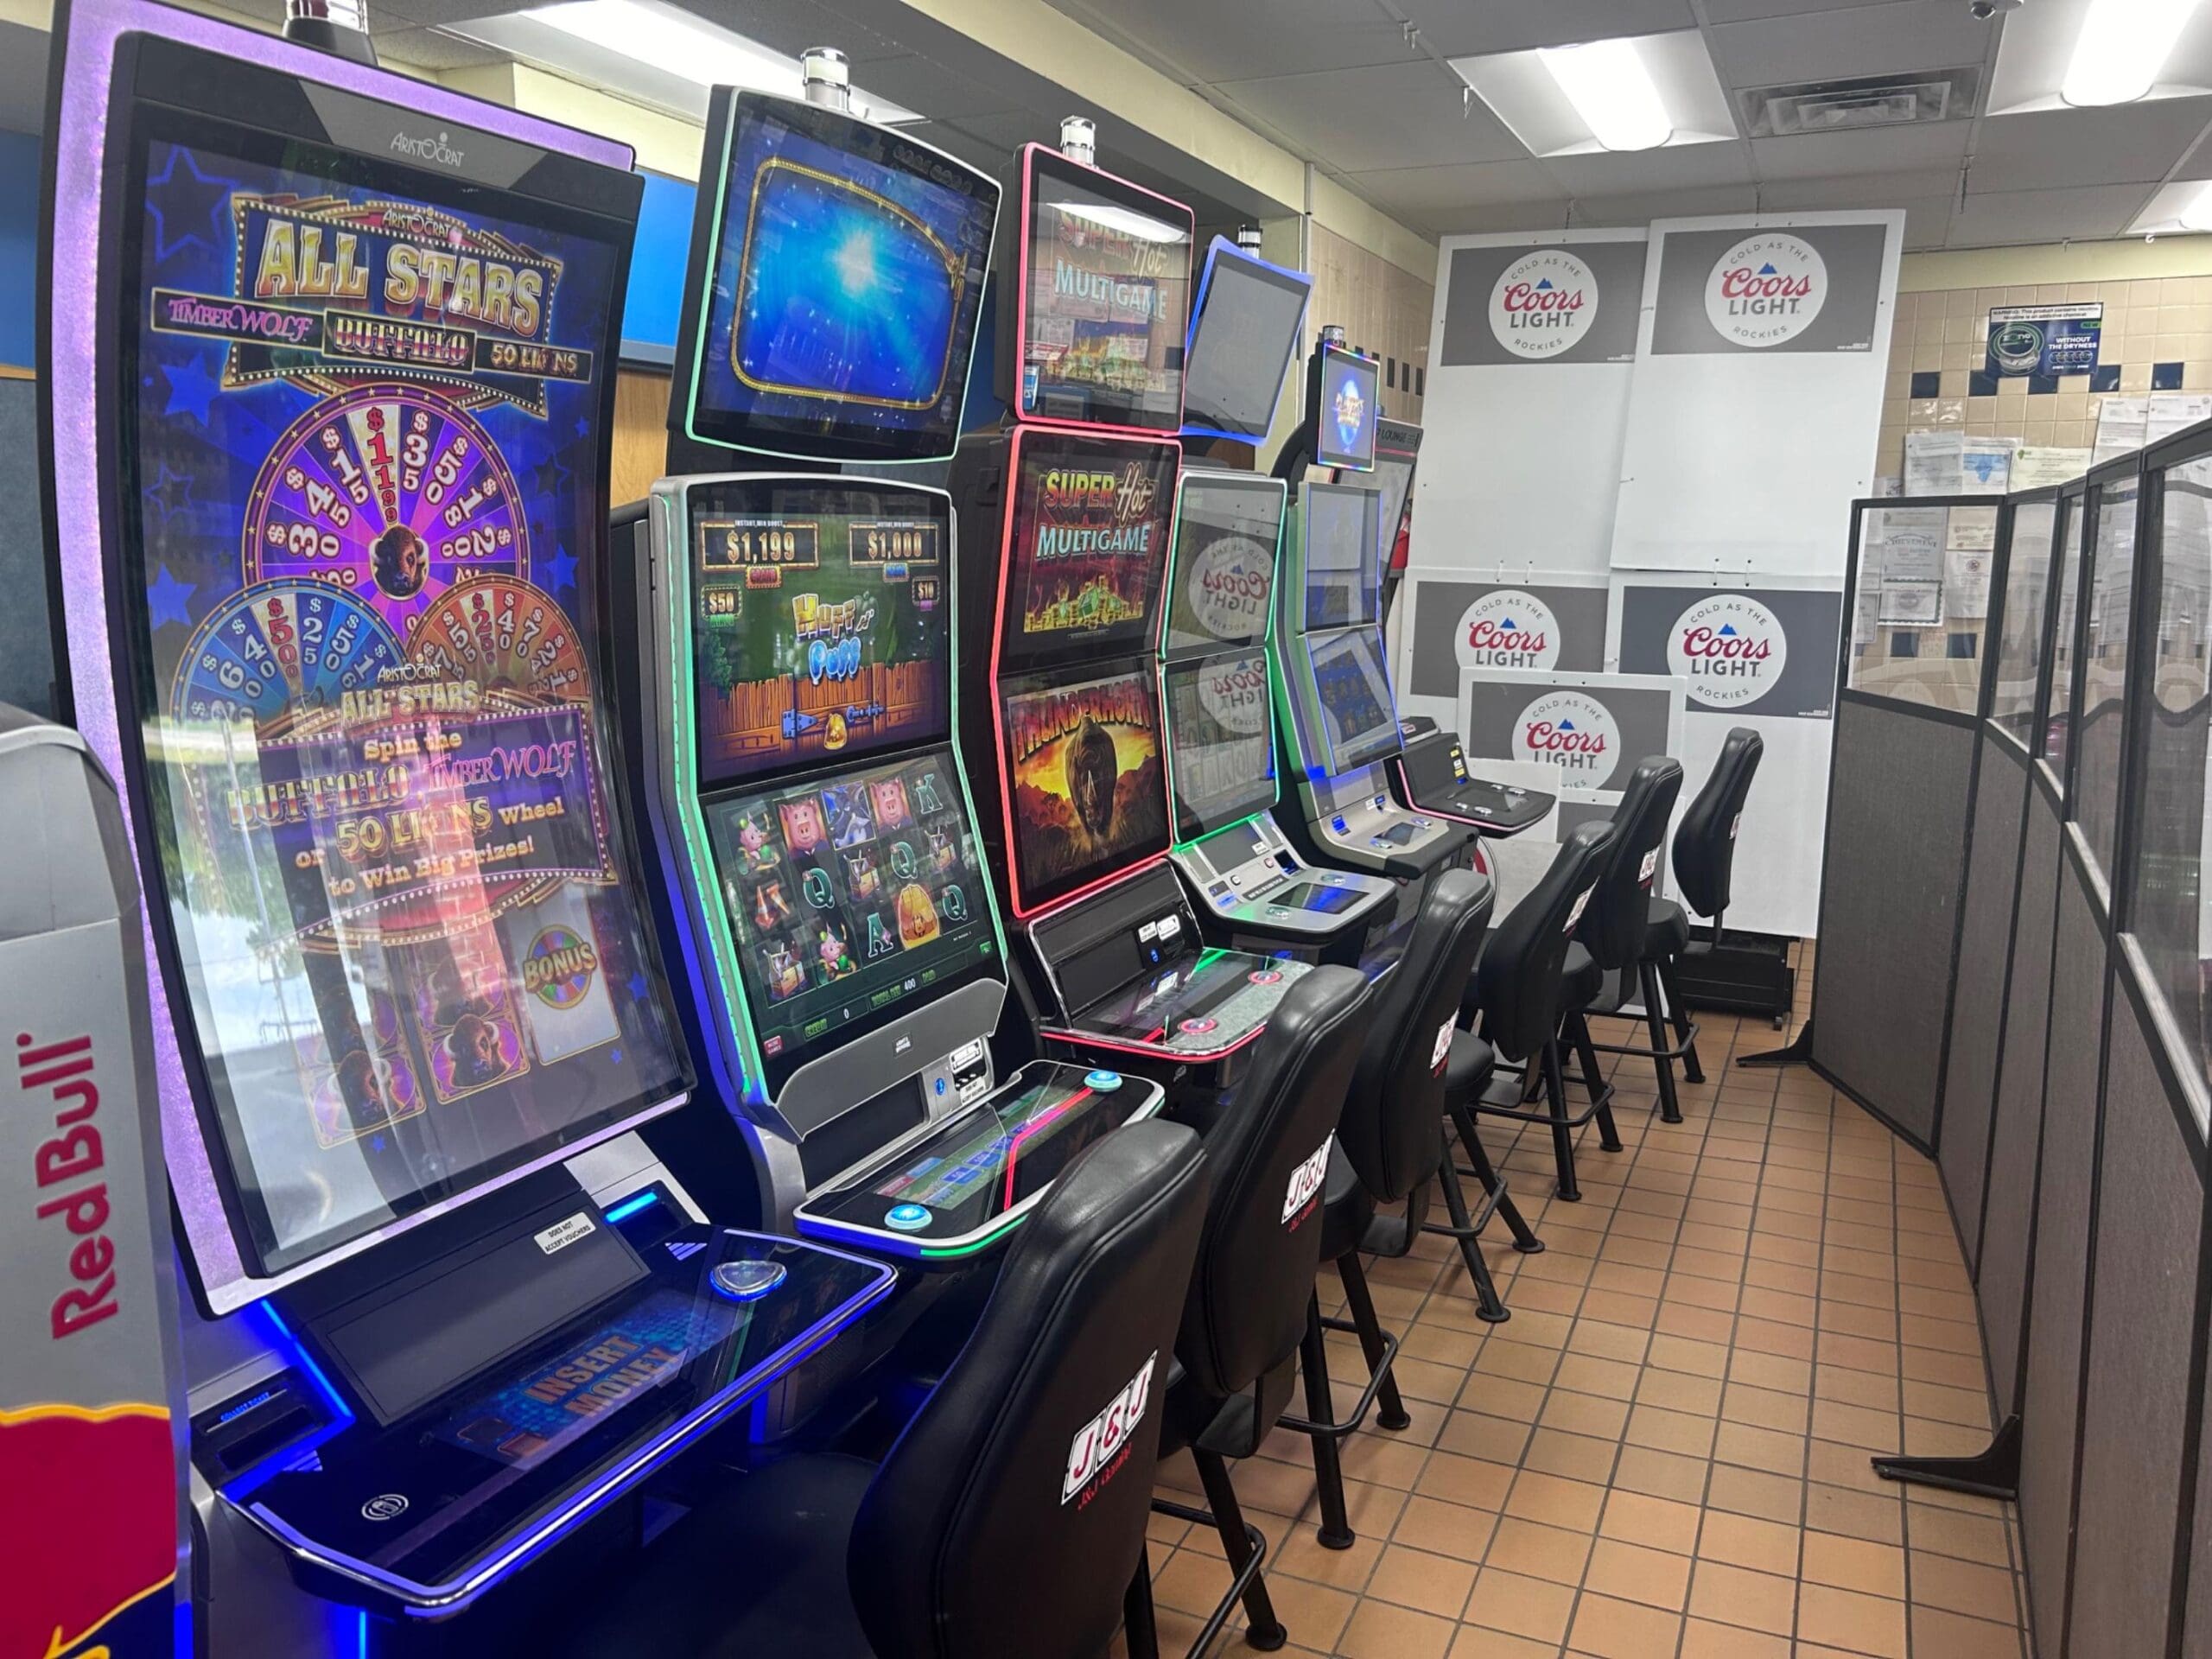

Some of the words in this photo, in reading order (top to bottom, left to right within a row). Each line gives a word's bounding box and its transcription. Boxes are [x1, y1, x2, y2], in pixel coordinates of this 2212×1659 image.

[391, 131, 465, 168] ARISTOCRAT
[383, 207, 451, 238] ARISTOCRAT
[1731, 244, 1761, 264] COLD
[1789, 245, 1808, 262] THE
[255, 218, 370, 301] ALL
[384, 245, 543, 338] STARS
[1511, 260, 1539, 280] COLD
[1563, 261, 1581, 277] THE
[1722, 268, 1811, 298] Coors
[1055, 257, 1167, 320] MULTIGAME
[1503, 283, 1584, 311] Coors
[1510, 312, 1574, 327] LIGHT
[1729, 298, 1800, 315] LIGHT
[334, 316, 472, 368] BUFFALO
[1515, 338, 1562, 351] ROCKIES
[1733, 326, 1787, 339] ROCKIES
[490, 344, 518, 368] 50
[1045, 471, 1116, 509] SUPER
[1115, 461, 1154, 524] Hot
[727, 530, 795, 563] $1,199
[868, 531, 922, 560] $1,000
[1036, 523, 1150, 561] MULTIGAME
[709, 592, 734, 613] $50
[918, 582, 934, 600] $10
[1475, 598, 1503, 617] COLD
[1525, 603, 1543, 620] THE
[1690, 604, 1720, 623] COLD
[1726, 602, 1741, 611] AS
[1747, 607, 1767, 626] THE
[1469, 620, 1547, 652] Coors
[1683, 626, 1771, 659] Coors
[378, 653, 442, 683] ARISTOCRAT
[1476, 650, 1537, 668] LIGHT
[1691, 659, 1762, 677] LIGHT
[341, 688, 392, 728] ALL
[397, 679, 481, 719] STARS
[1696, 685, 1750, 700] ROCKIES
[1532, 700, 1560, 717] COLD
[1584, 704, 1603, 721] THE
[363, 734, 419, 762] Spin
[425, 732, 463, 753] the
[1526, 721, 1606, 753] Coors
[916, 773, 944, 815] K
[296, 848, 326, 869] or
[337, 819, 386, 858] 50
[498, 797, 565, 827] Wheel
[328, 875, 357, 897] to
[361, 862, 414, 892] Win
[415, 853, 456, 880] Big
[461, 835, 536, 869] Prizes!
[890, 841, 918, 880] Q
[802, 867, 836, 909] Q
[942, 885, 969, 922] Q
[867, 912, 893, 959] A
[523, 942, 599, 992] BONUS
[842, 1007, 851, 1020] 0
[548, 1227, 563, 1238] DOES
[562, 1220, 574, 1231] NOT
[544, 1237, 564, 1252] ACCEPT
[522, 1335, 641, 1404] INSERT
[563, 1346, 679, 1418] MONEY
